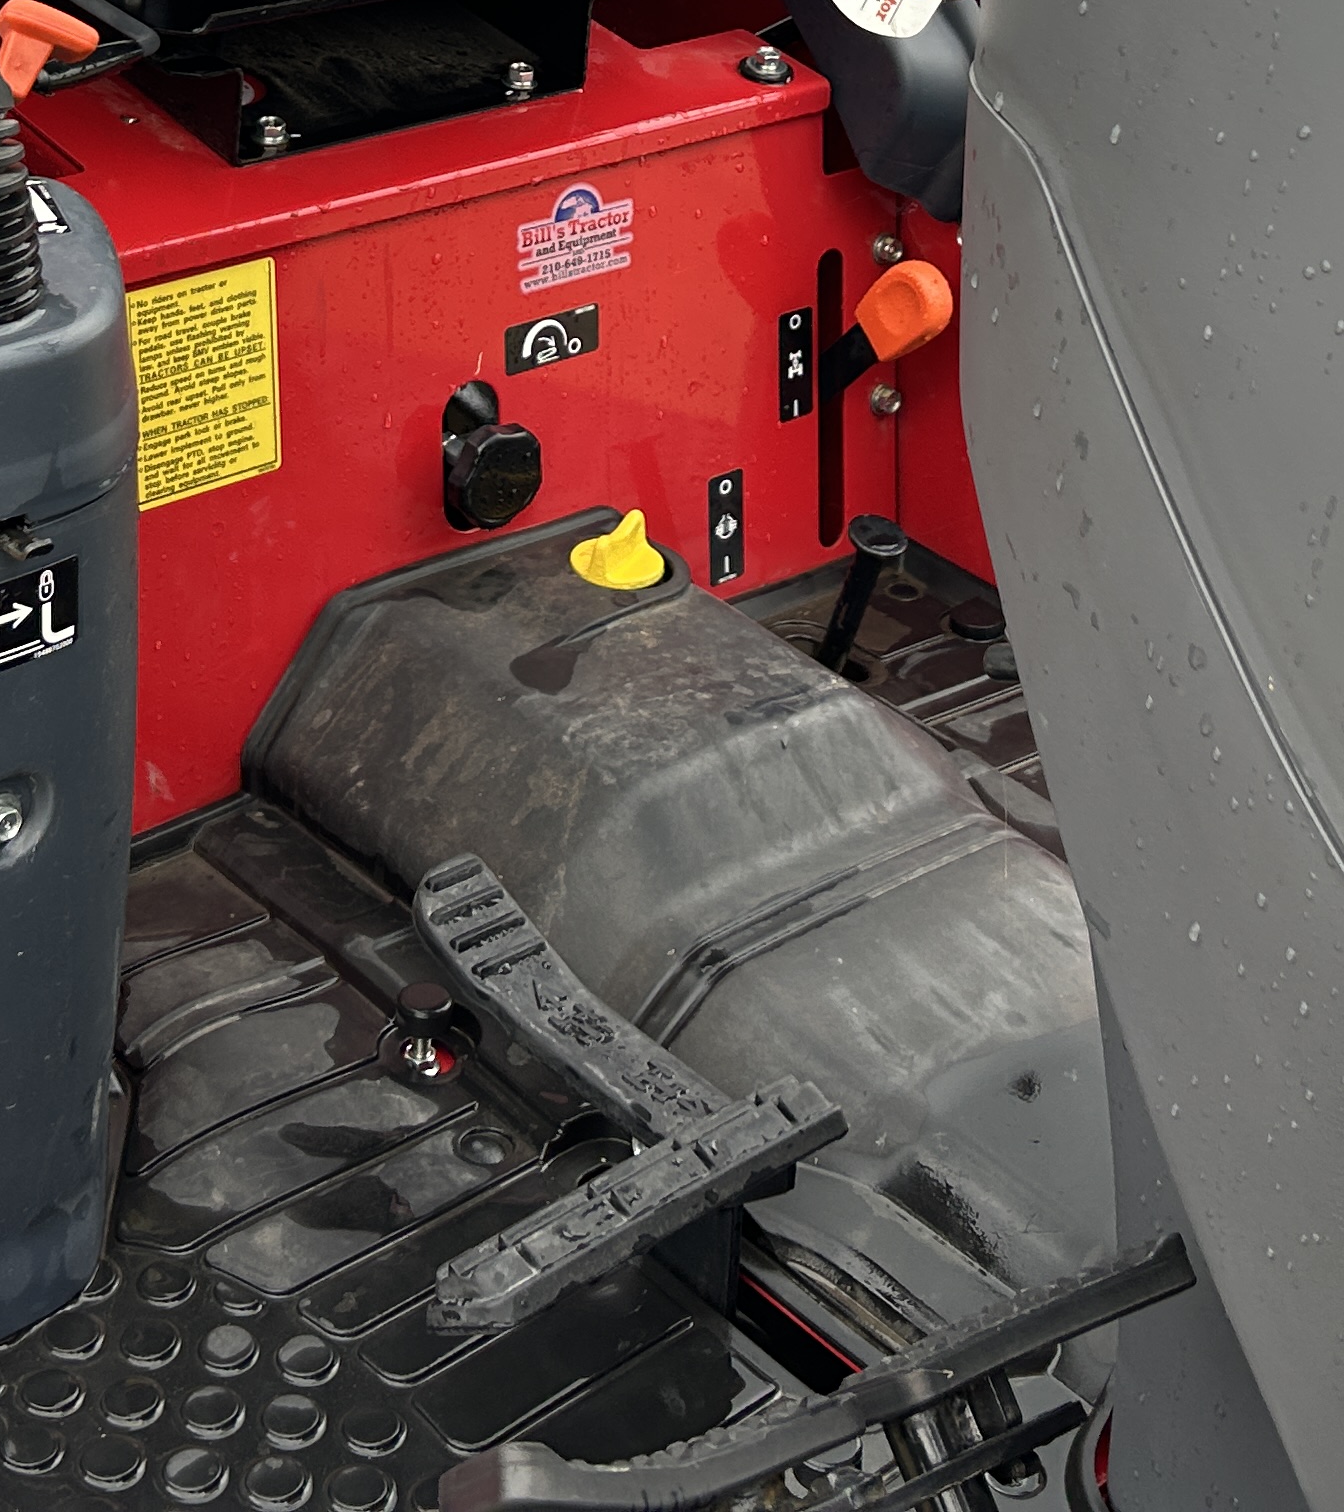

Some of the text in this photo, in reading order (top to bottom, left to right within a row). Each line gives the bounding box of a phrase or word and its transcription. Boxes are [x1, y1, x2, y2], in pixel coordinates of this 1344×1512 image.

[521, 211, 628, 247] Bill's Tractor
[535, 242, 555, 256] and
[558, 229, 616, 250] Equipment
[139, 362, 188, 382] TRACTORS
[193, 356, 212, 367] CAN
[218, 350, 229, 360] BE
[142, 425, 167, 437] WHEN
[171, 413, 208, 429] TRACTOR
[212, 406, 228, 417] HAS
